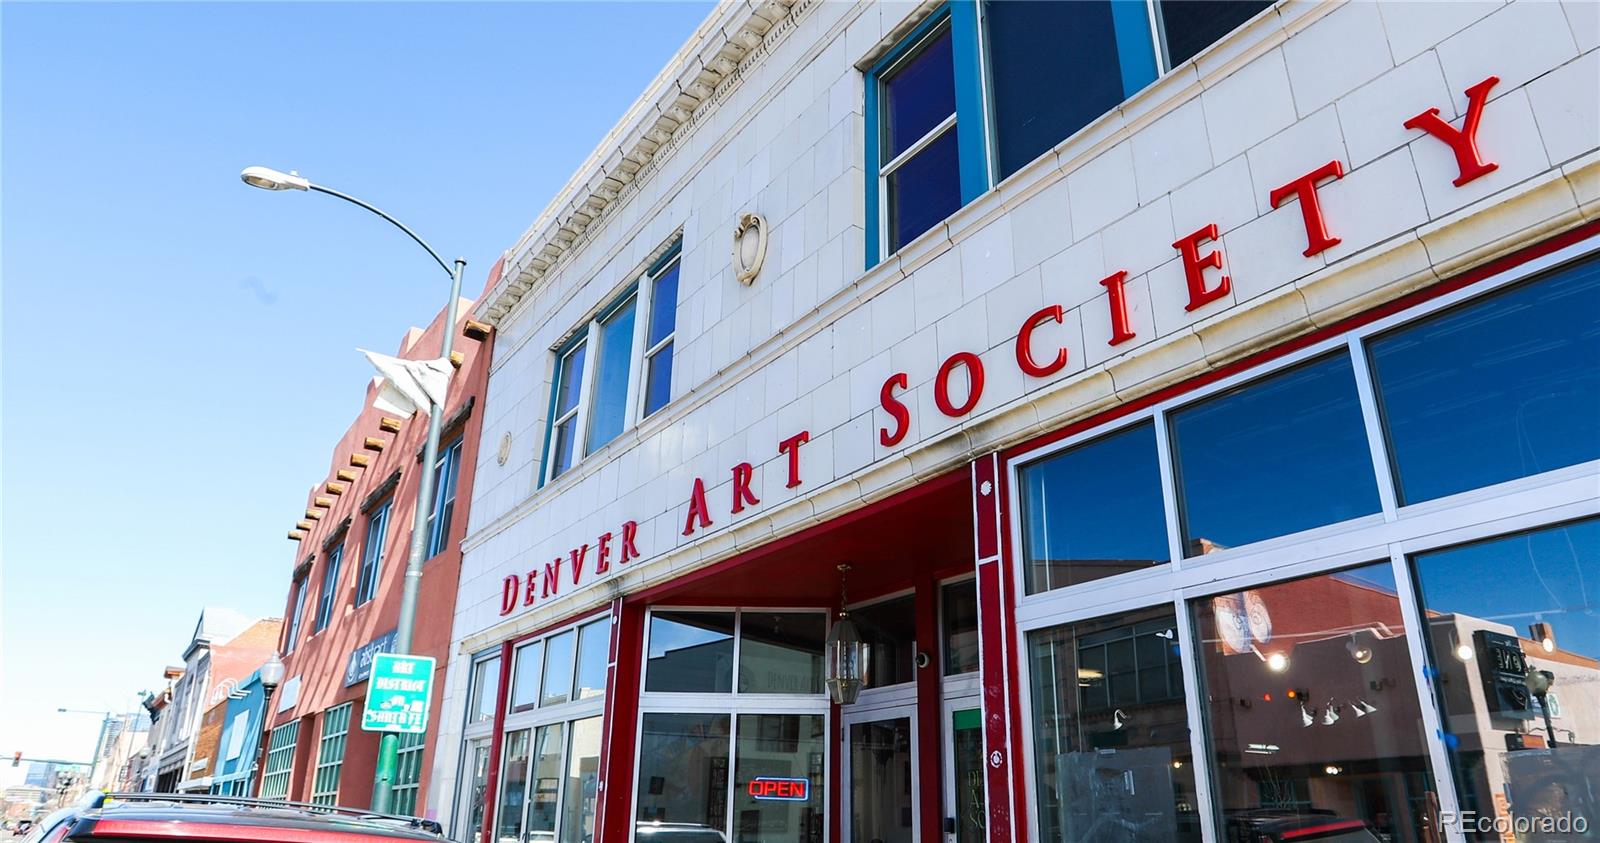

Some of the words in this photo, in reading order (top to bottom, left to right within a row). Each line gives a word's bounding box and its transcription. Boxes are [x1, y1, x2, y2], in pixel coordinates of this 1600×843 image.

[499, 520, 640, 617] DENVER
[681, 430, 809, 536] ART
[879, 76, 1500, 447] SOCIETY
[392, 661, 415, 674] ART
[376, 677, 426, 692] DISTRICT
[748, 780, 805, 797] OPEN
